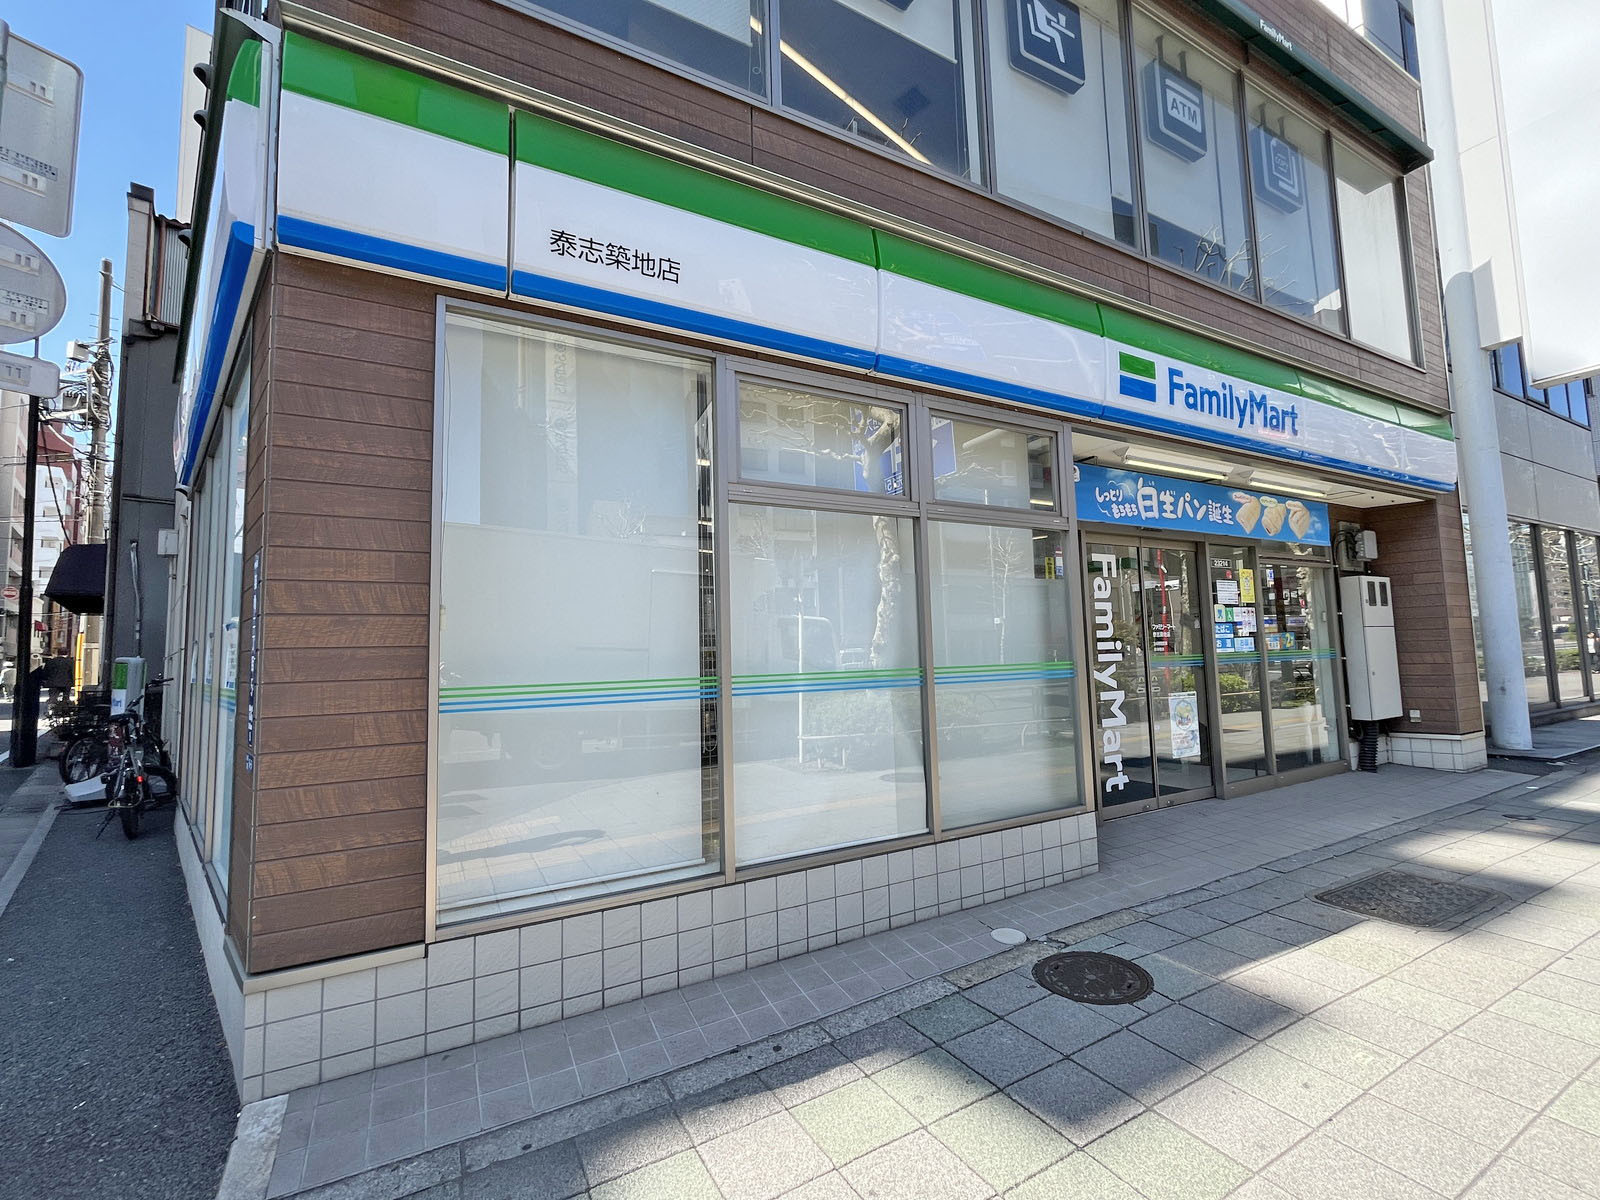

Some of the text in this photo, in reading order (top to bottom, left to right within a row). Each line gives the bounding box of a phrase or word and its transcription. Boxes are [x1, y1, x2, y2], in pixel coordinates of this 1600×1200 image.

[1259, 18, 1293, 51] FamilyMart
[1170, 97, 1198, 126] ATM
[549, 229, 681, 284] 泰志築地店
[1167, 366, 1299, 437] FamilyMart
[1095, 486, 1124, 503] しっとり
[1091, 553, 1130, 793] FamilyMart
